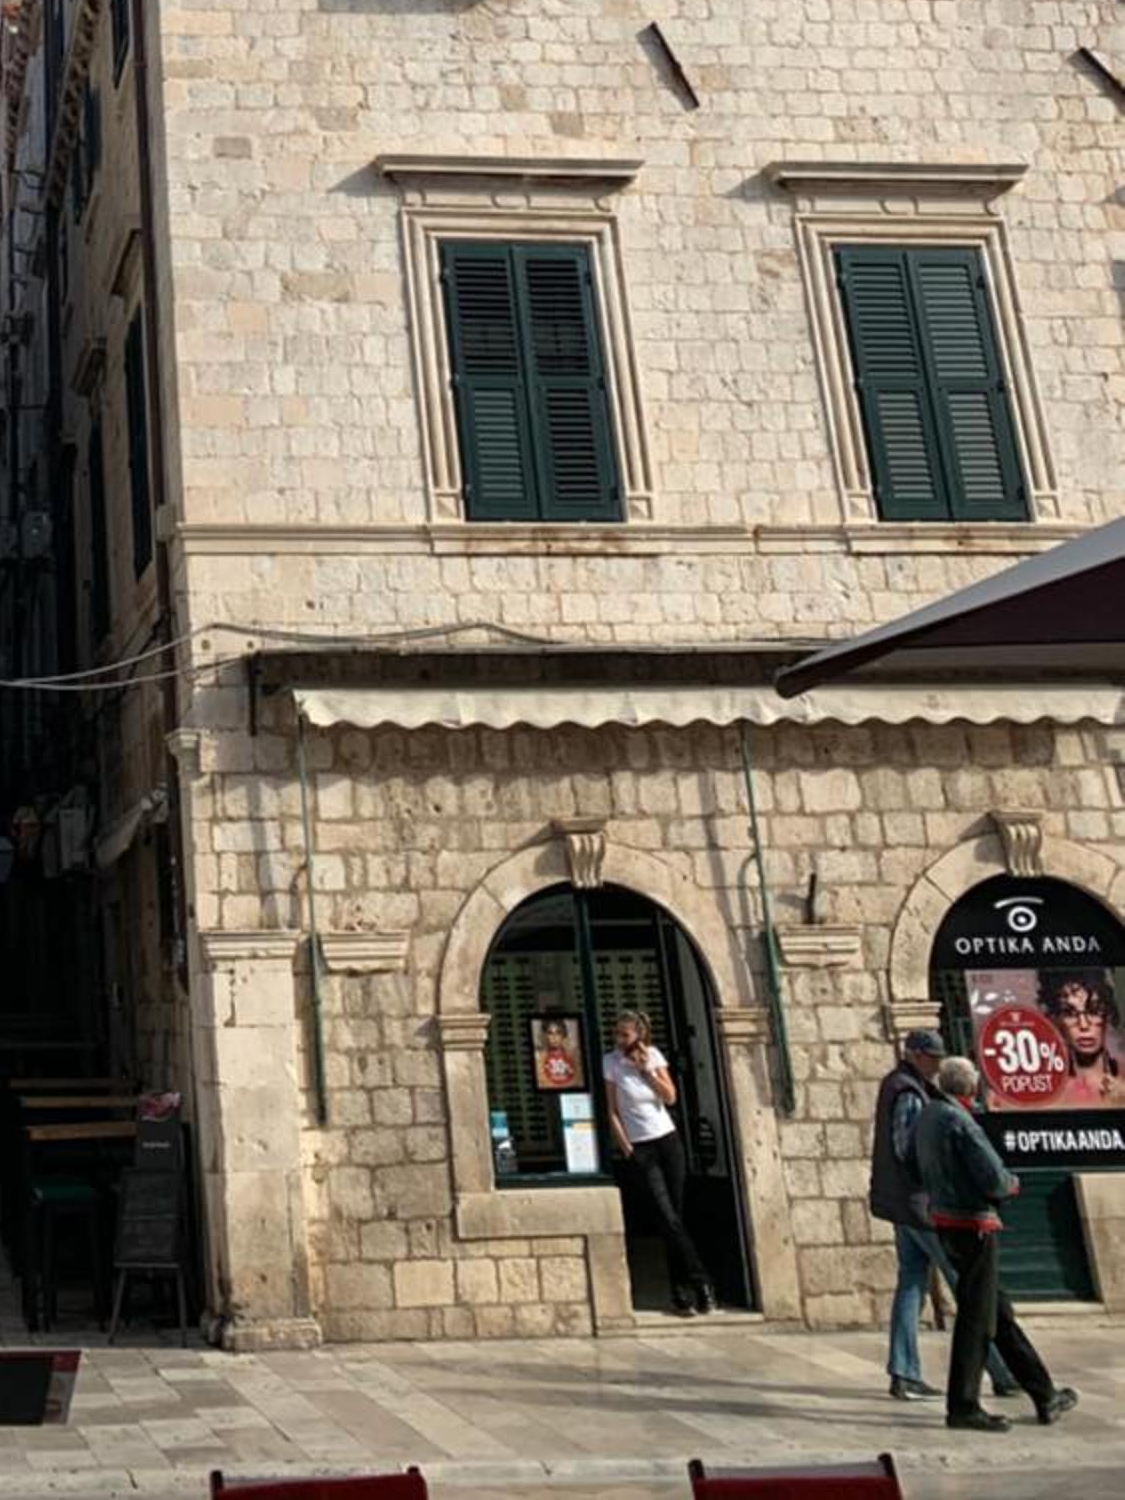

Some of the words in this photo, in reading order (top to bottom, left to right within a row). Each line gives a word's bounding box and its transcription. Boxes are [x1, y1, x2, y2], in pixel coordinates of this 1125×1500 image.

[955, 936, 1035, 954] OPTIKA
[1042, 935, 1101, 953] ANDA
[983, 1029, 1064, 1073] -30%
[1002, 1074, 1052, 1093] POPUST
[1003, 1128, 1125, 1152] #OPTIKAANDA
